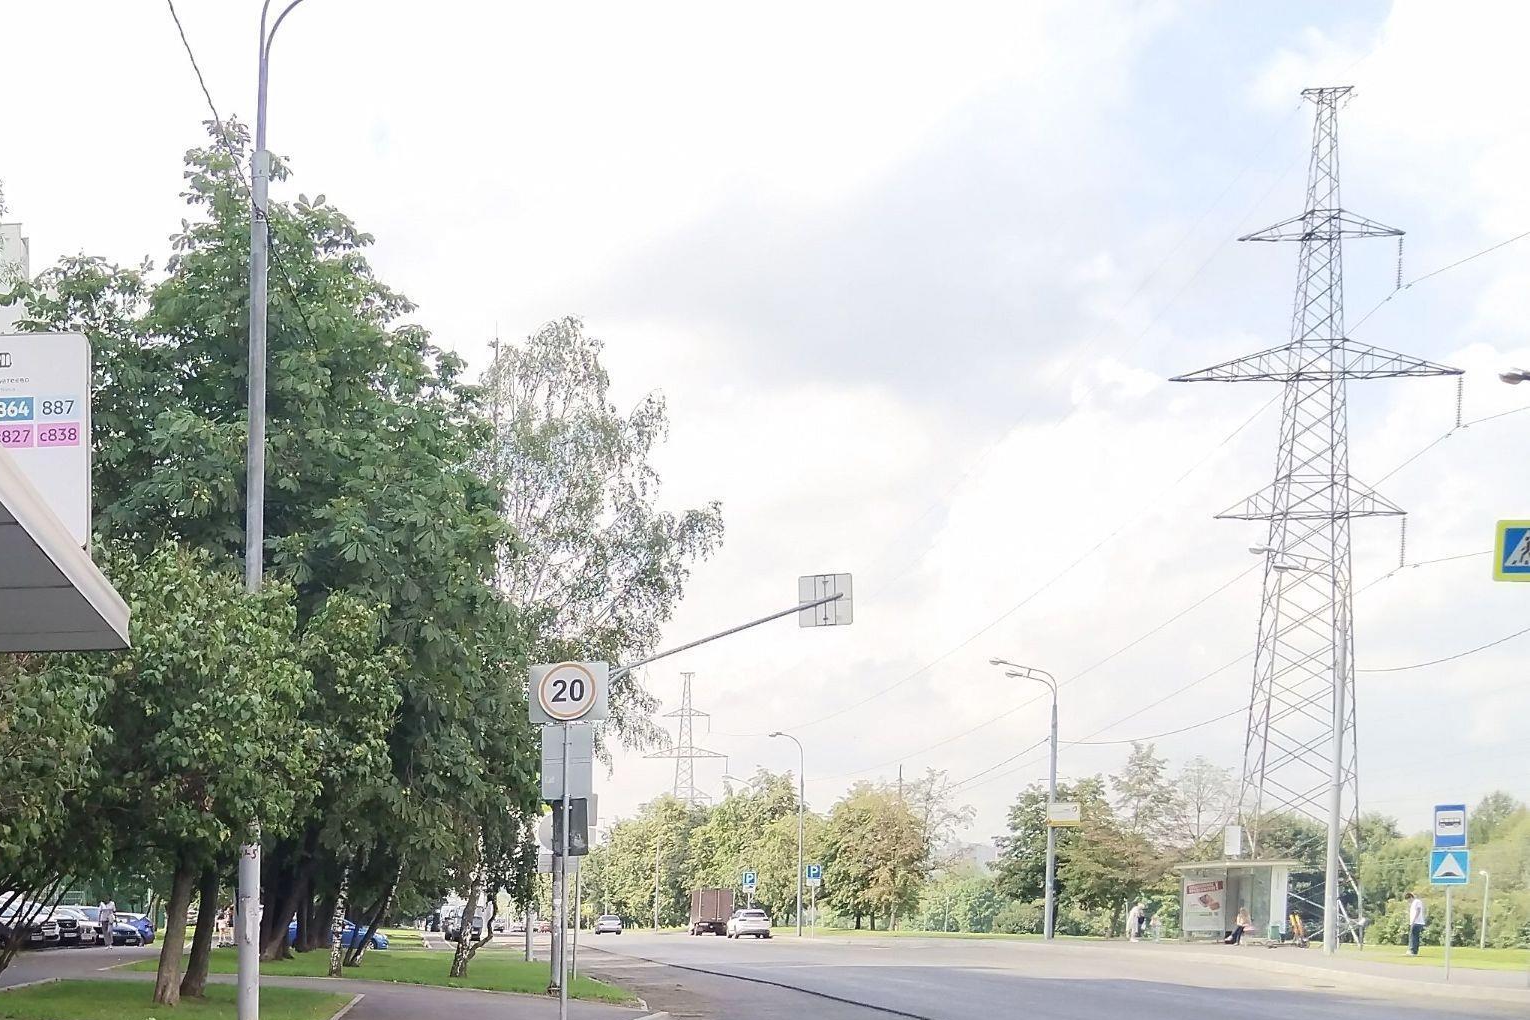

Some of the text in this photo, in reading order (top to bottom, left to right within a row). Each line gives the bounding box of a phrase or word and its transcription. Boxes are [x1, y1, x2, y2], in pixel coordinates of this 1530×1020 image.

[42, 400, 75, 415] 887
[39, 428, 77, 442] с838
[551, 679, 585, 702] 20
